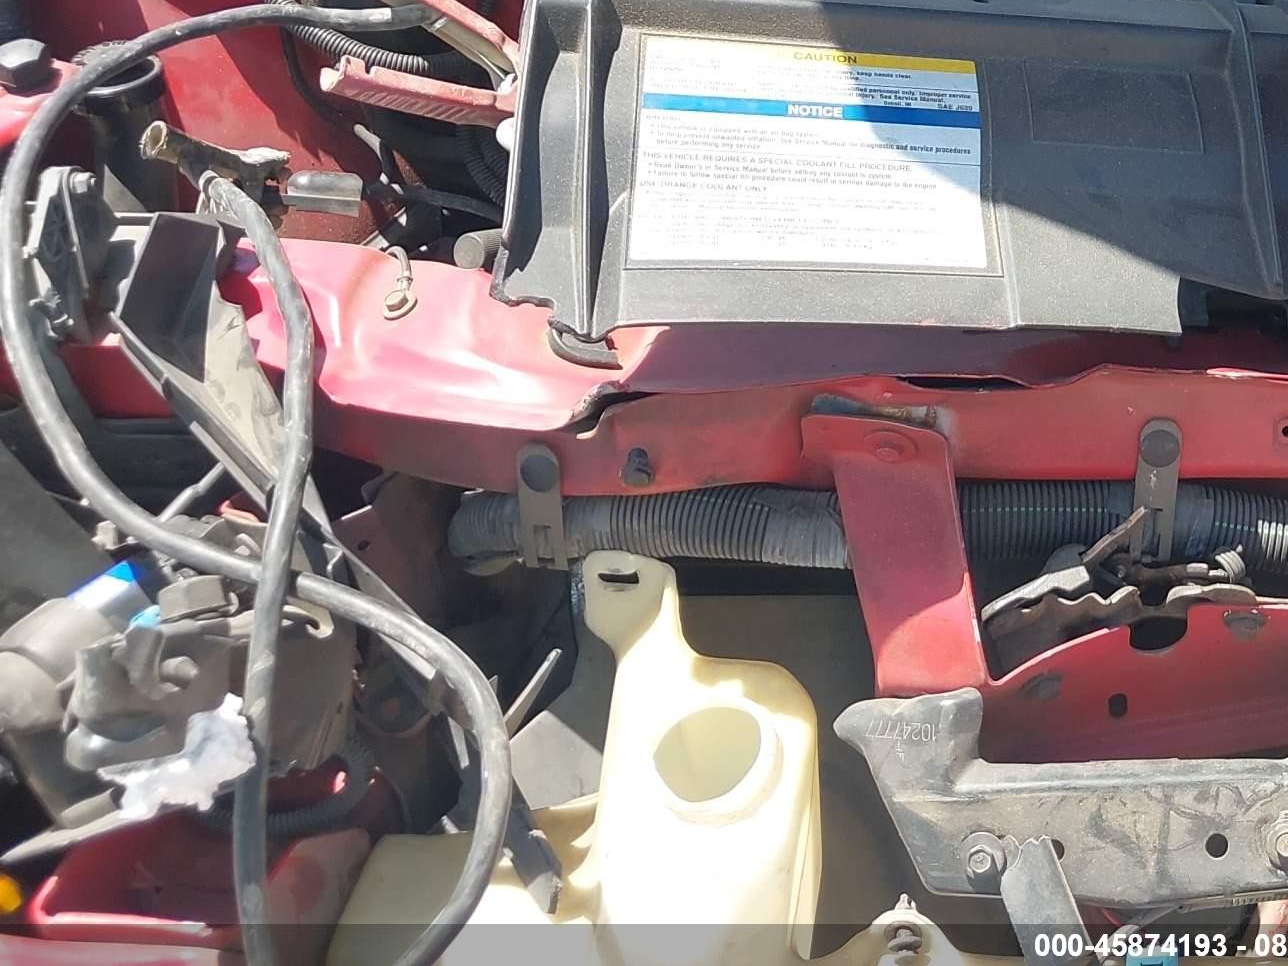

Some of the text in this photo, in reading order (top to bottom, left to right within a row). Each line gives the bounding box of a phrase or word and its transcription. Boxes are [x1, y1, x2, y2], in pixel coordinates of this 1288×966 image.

[793, 51, 858, 65] CAUTION
[868, 88, 901, 96] personnel
[894, 94, 918, 102] Service
[920, 96, 946, 104] Manual.
[787, 103, 844, 119] NOTICE
[860, 141, 895, 151] diagnostic
[896, 143, 908, 151] and
[909, 144, 934, 153] service
[935, 146, 972, 155] procedures
[643, 150, 662, 159] THIS
[664, 152, 700, 161] VEHICLE
[703, 154, 747, 163] REQUIRES
[757, 156, 793, 166] SPECIAL
[796, 158, 837, 168] COOLANT
[839, 162, 856, 170] FILL
[865, 718, 937, 742] 10247777
